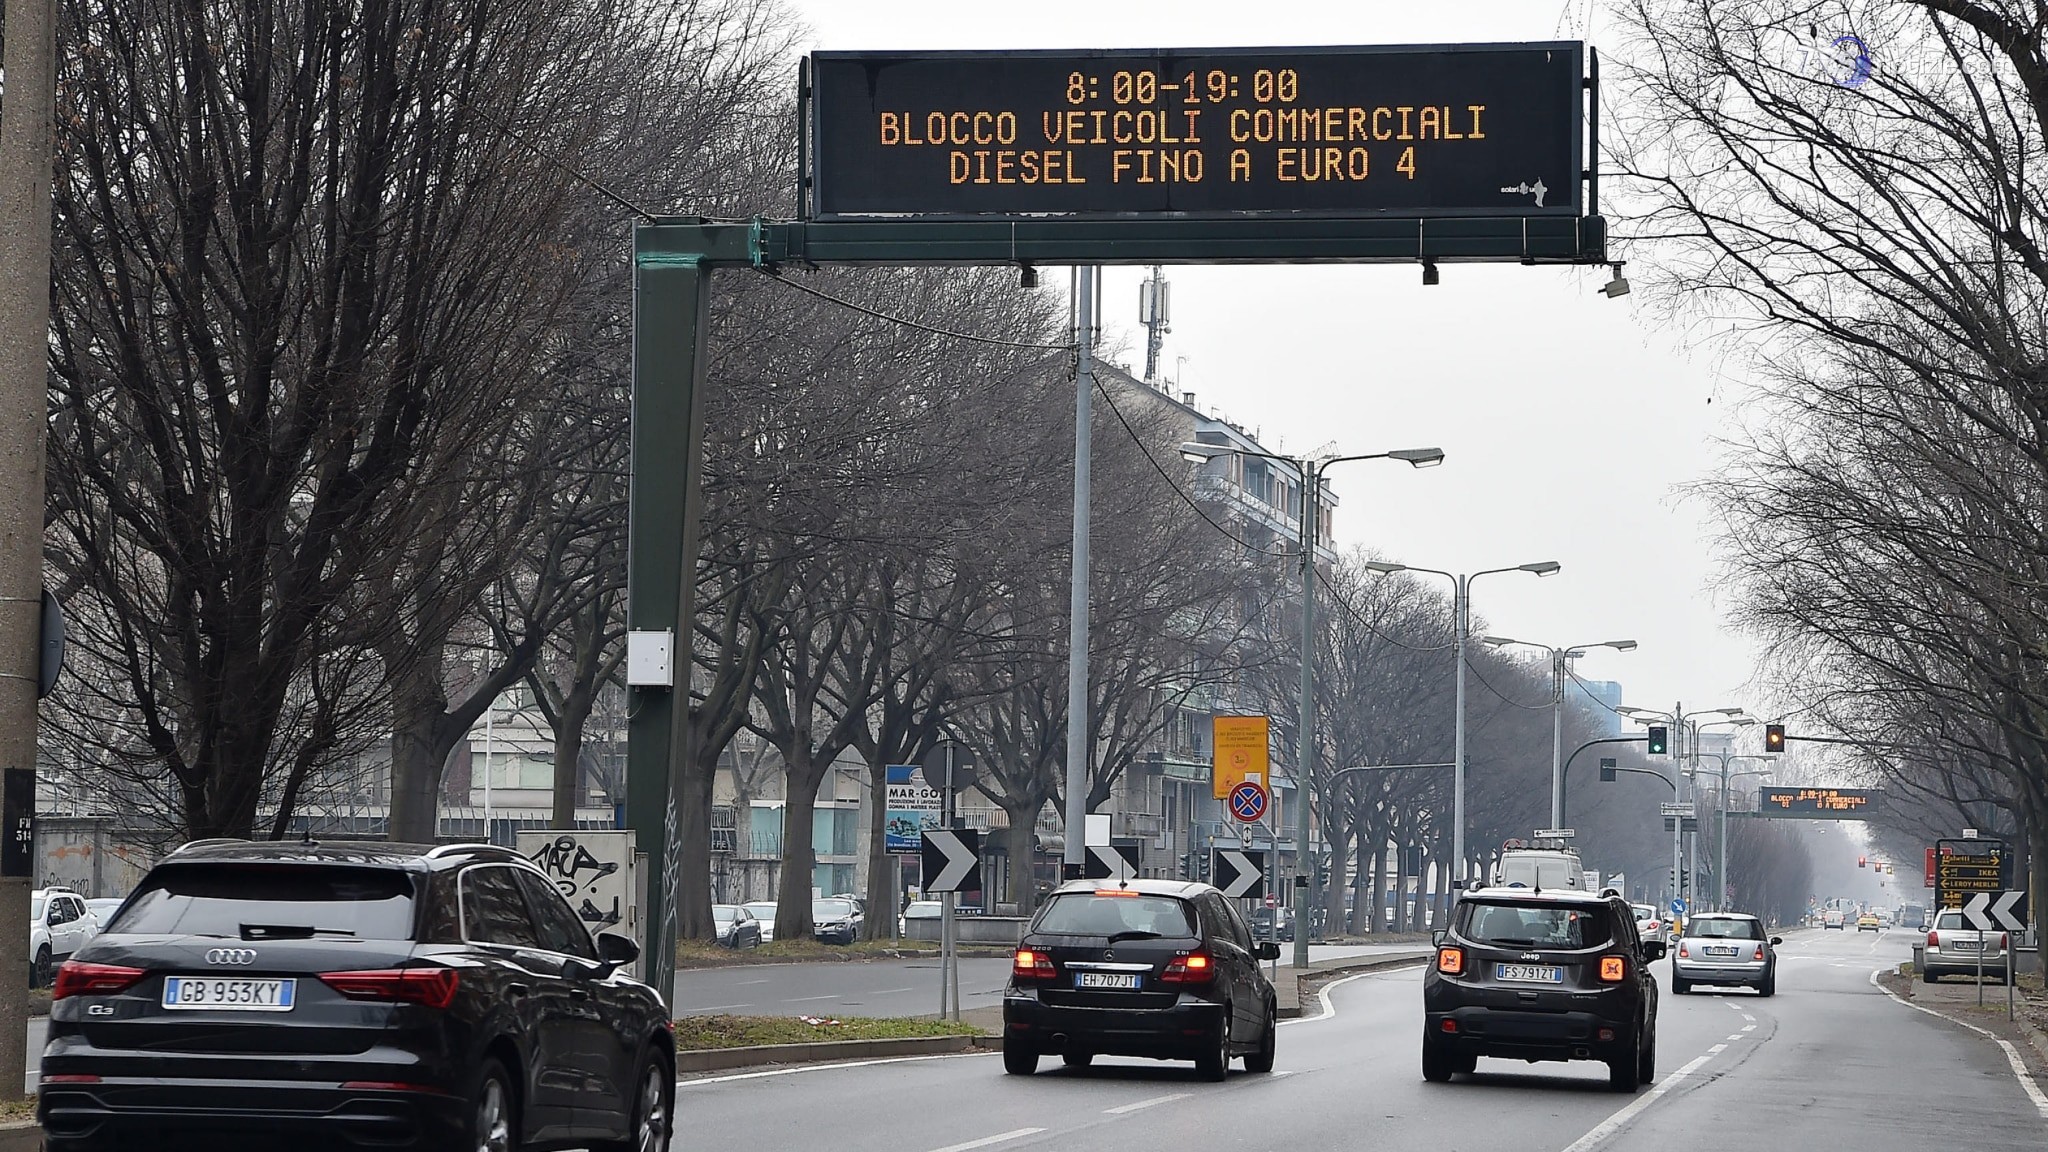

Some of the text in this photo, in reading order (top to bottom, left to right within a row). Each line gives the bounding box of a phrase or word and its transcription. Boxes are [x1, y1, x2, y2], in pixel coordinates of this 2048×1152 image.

[880, 105, 1487, 146] BLOCCO VEICOLI COMMERCIALI
[949, 146, 1416, 185] DIESEL FINO A EURO 4
[889, 788, 942, 799] MAR-GO
[1973, 881, 1999, 889] MERLIN
[1520, 952, 1540, 961] Jeep
